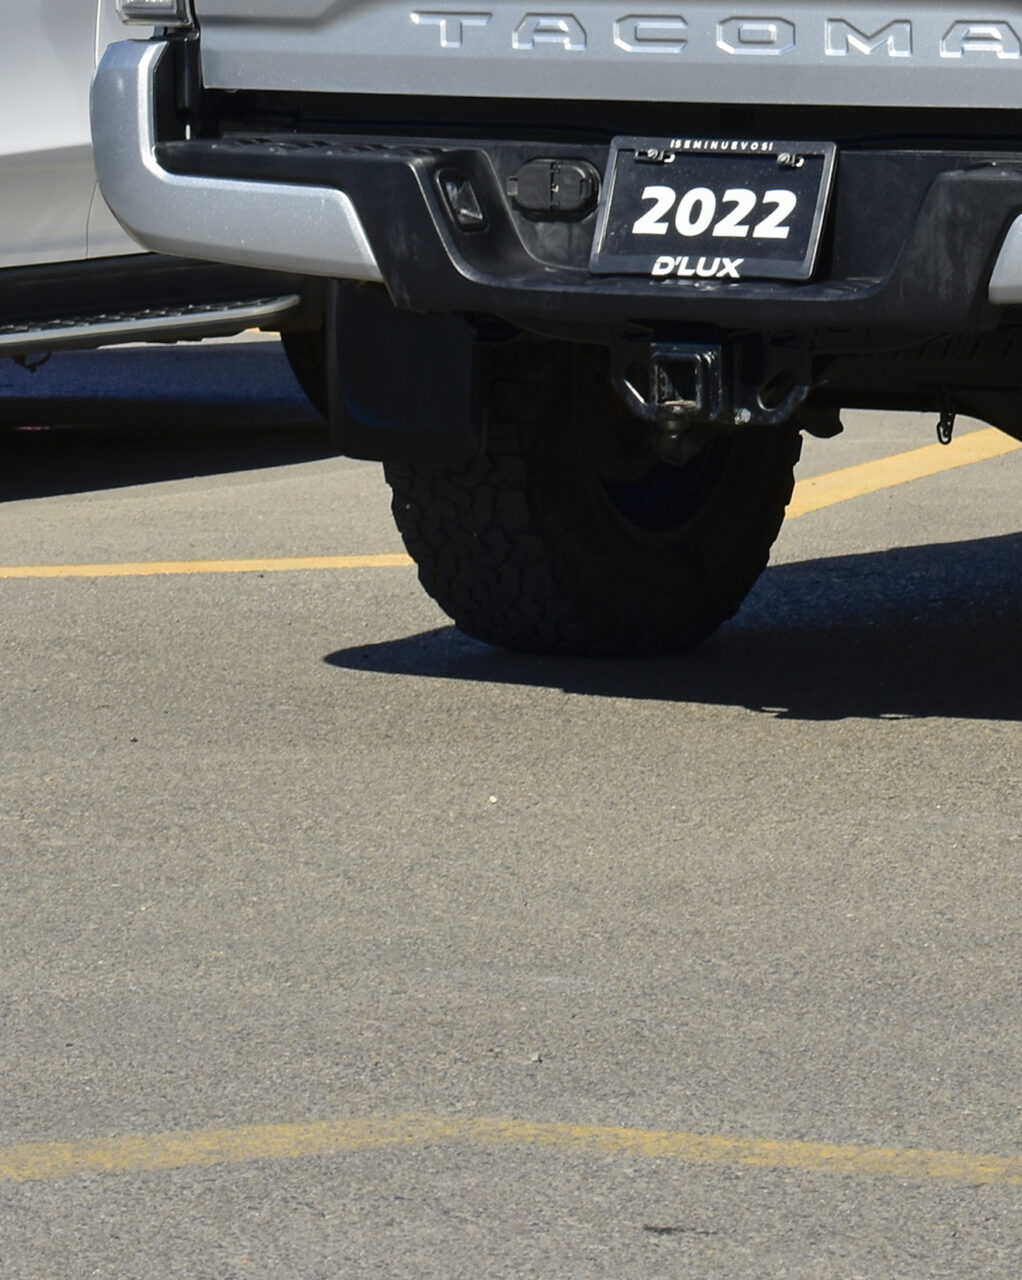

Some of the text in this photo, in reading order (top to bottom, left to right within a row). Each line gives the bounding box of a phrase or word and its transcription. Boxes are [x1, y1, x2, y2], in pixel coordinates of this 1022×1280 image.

[410, 11, 1022, 59] TACOMA
[632, 185, 797, 239] 2022
[651, 256, 744, 278] D'LUX
